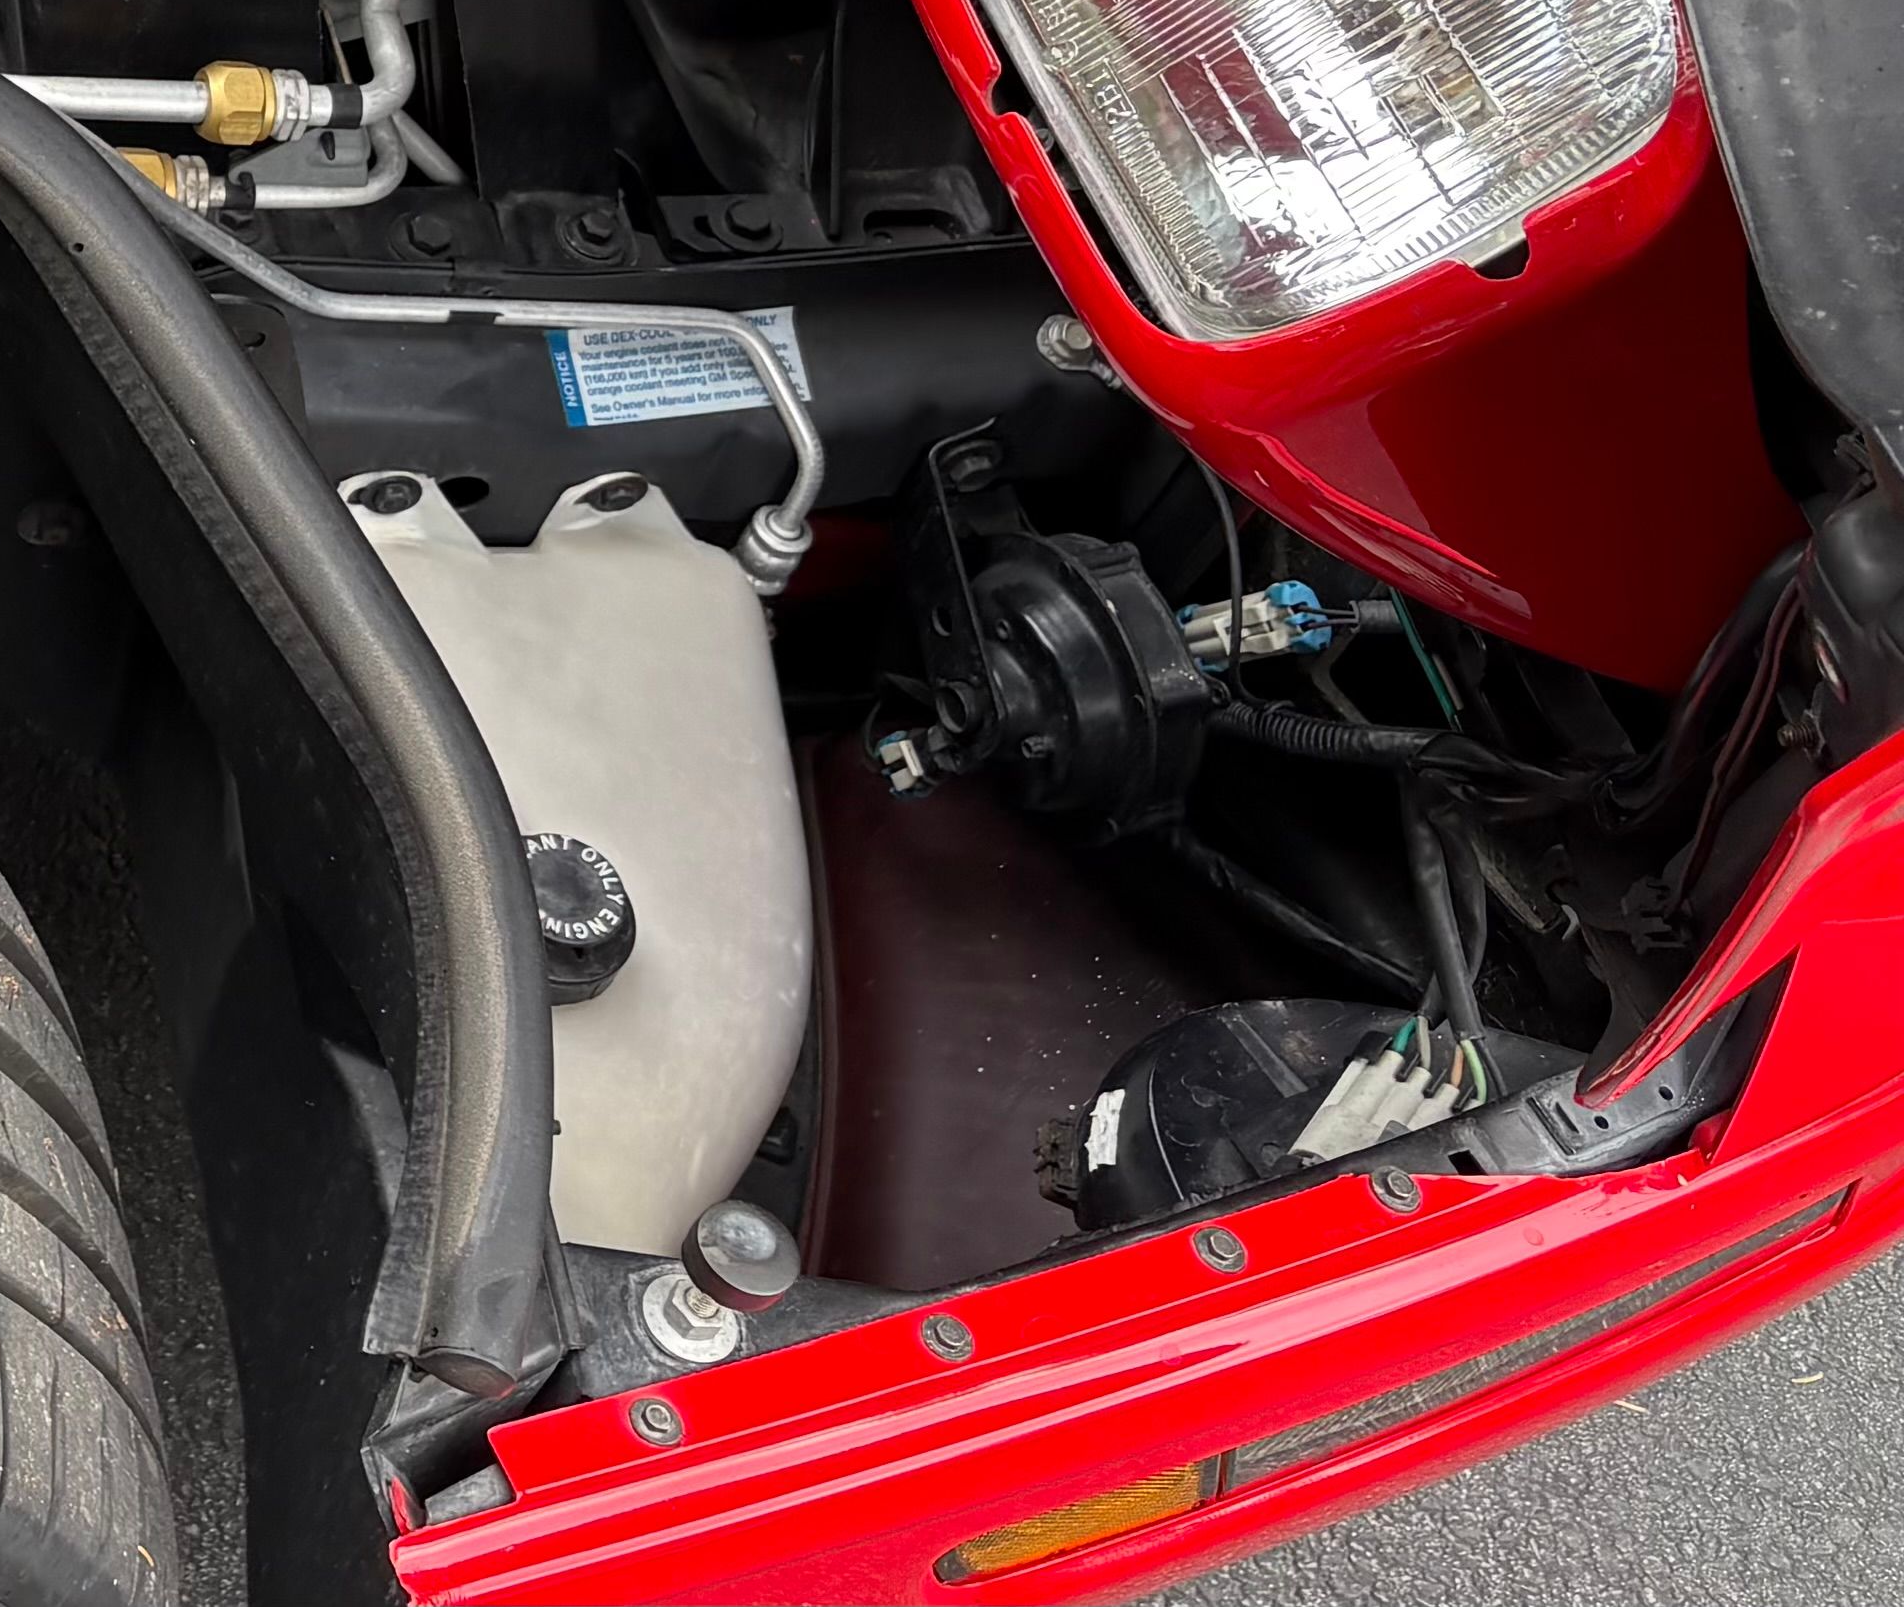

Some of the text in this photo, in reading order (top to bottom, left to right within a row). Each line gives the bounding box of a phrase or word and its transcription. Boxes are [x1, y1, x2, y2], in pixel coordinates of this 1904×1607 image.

[578, 334, 726, 361] Your engine coolant does not
[583, 332, 608, 346] USE
[581, 355, 645, 371] maintenance
[649, 354, 662, 365] for
[674, 351, 703, 365] years
[705, 350, 715, 359] or
[658, 366, 679, 379] you
[681, 362, 701, 374] add
[556, 351, 577, 407] NOTICE
[587, 383, 622, 398] orange
[624, 378, 662, 392] coolant
[664, 373, 707, 389] meeting
[708, 371, 729, 383] GM
[591, 401, 611, 414] See
[613, 397, 655, 411] Owner's
[657, 392, 696, 407] Manual
[697, 390, 712, 402] for
[713, 388, 741, 400] more
[581, 847, 624, 905] ONLY
[541, 900, 622, 943] ENGIN
